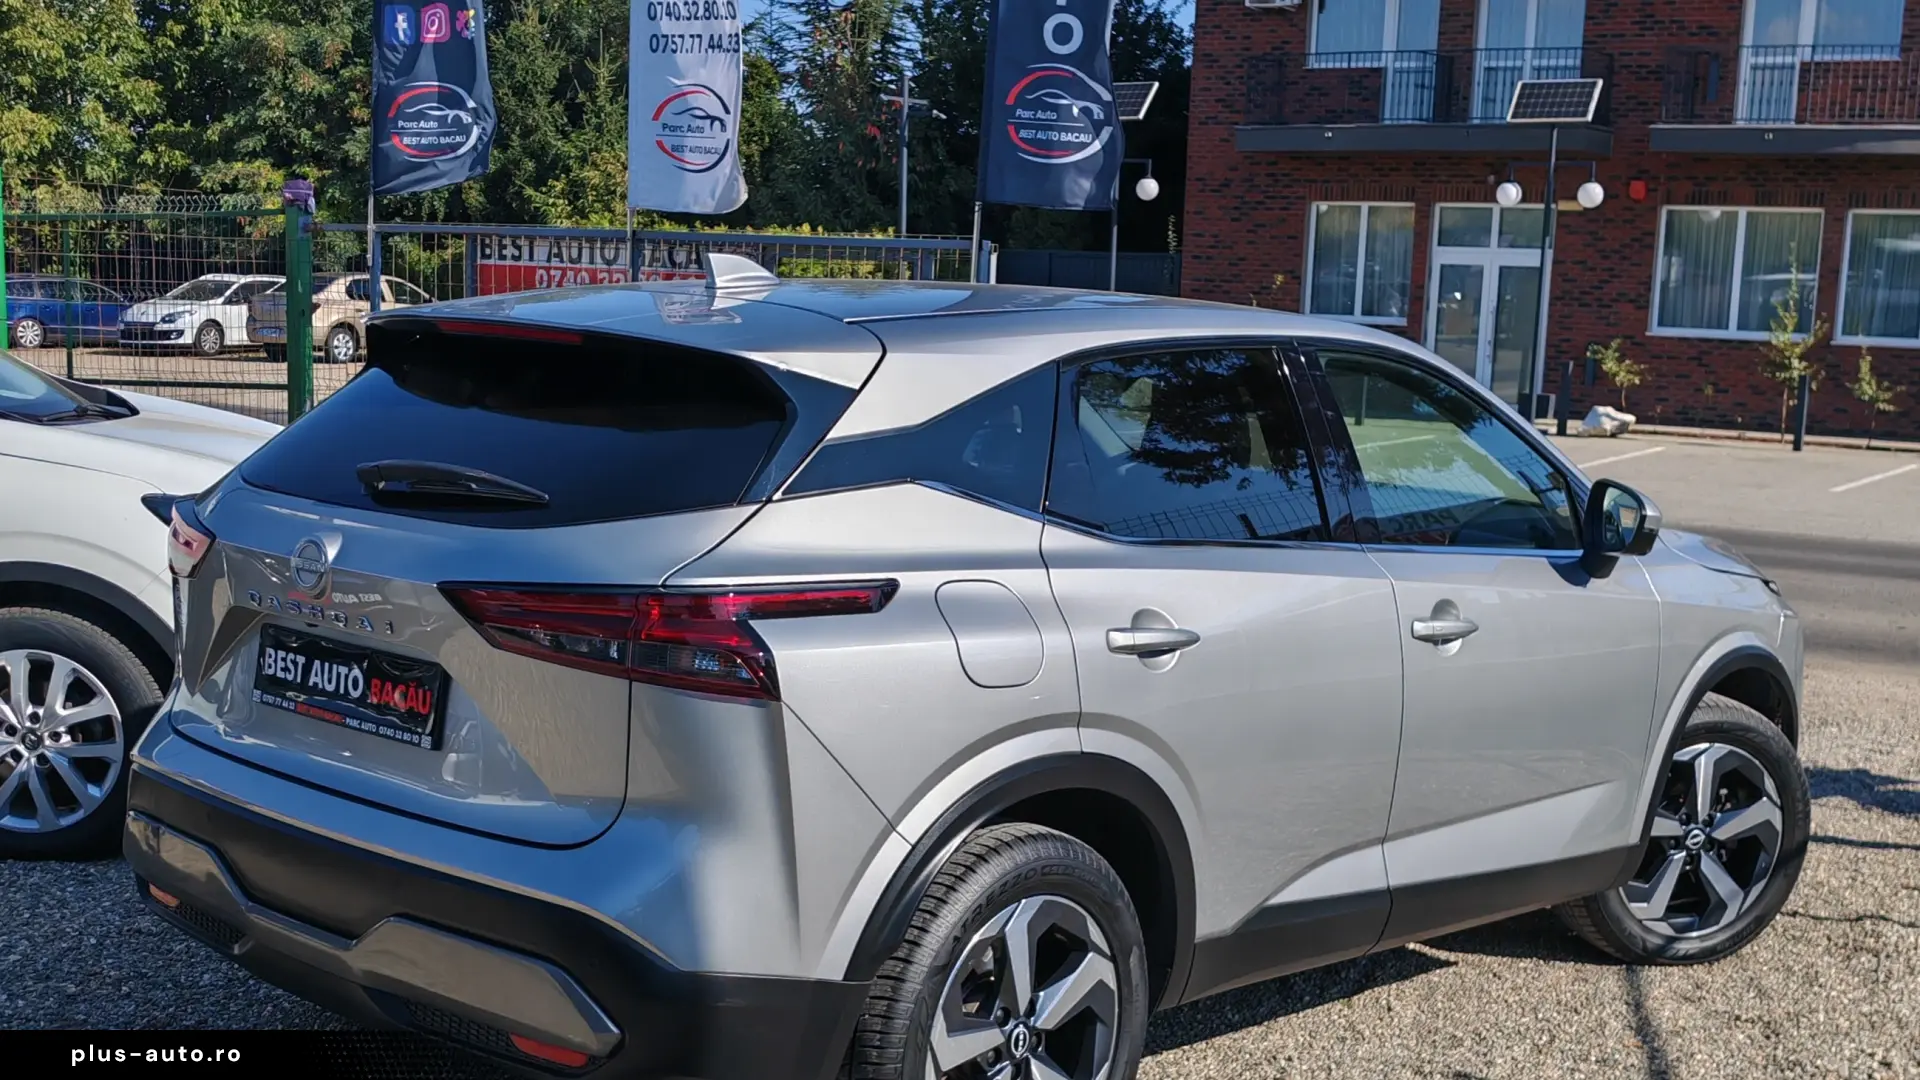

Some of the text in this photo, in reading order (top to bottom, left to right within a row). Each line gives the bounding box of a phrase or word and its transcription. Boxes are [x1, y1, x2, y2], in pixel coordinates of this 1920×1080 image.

[649, 32, 740, 54] 0757.77.44.33
[1015, 108, 1057, 120] Parc Auto
[397, 120, 438, 129] Parc Auto
[661, 123, 705, 134] Parc Auto
[402, 136, 421, 145] BEST
[421, 136, 439, 145] AUTO
[1018, 129, 1092, 143] BEST AUTO BACAU
[670, 144, 688, 153] BEST
[688, 145, 703, 154] AUTO
[480, 237, 536, 262] BEST
[546, 239, 620, 266] AUTO
[264, 647, 306, 684] BEST
[308, 659, 364, 699] AUTO
[370, 677, 432, 715] BACĂU
[360, 722, 377, 732] AUTO
